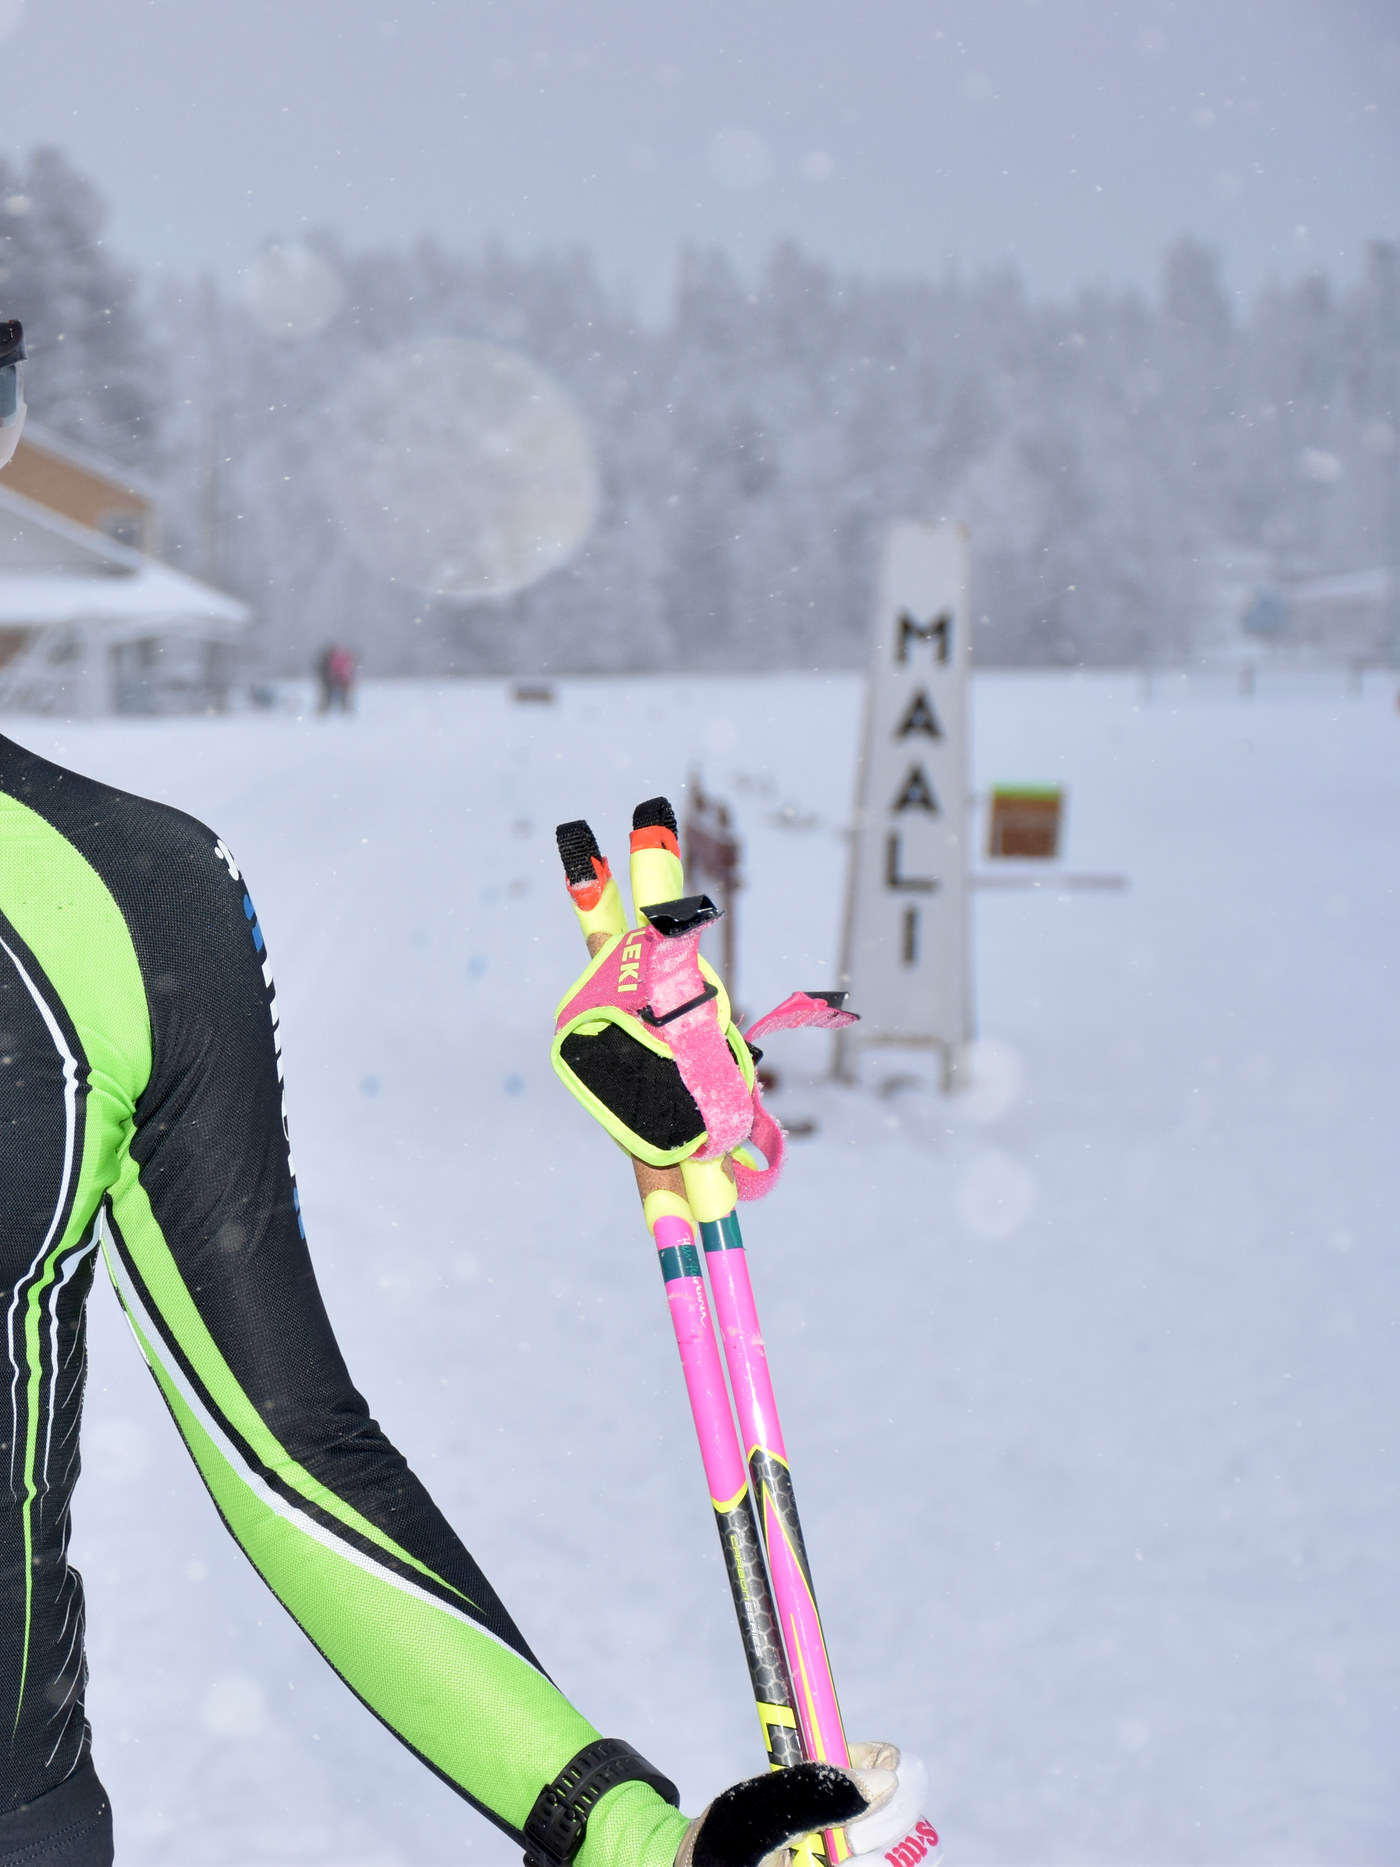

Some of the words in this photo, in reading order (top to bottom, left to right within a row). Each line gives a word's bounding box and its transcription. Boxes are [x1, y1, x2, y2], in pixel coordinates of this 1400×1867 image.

[884, 610, 951, 966] MAALI
[617, 929, 646, 993] LEKI
[730, 1534, 751, 1601] CARBON
[744, 1599, 764, 1660] SERIES
